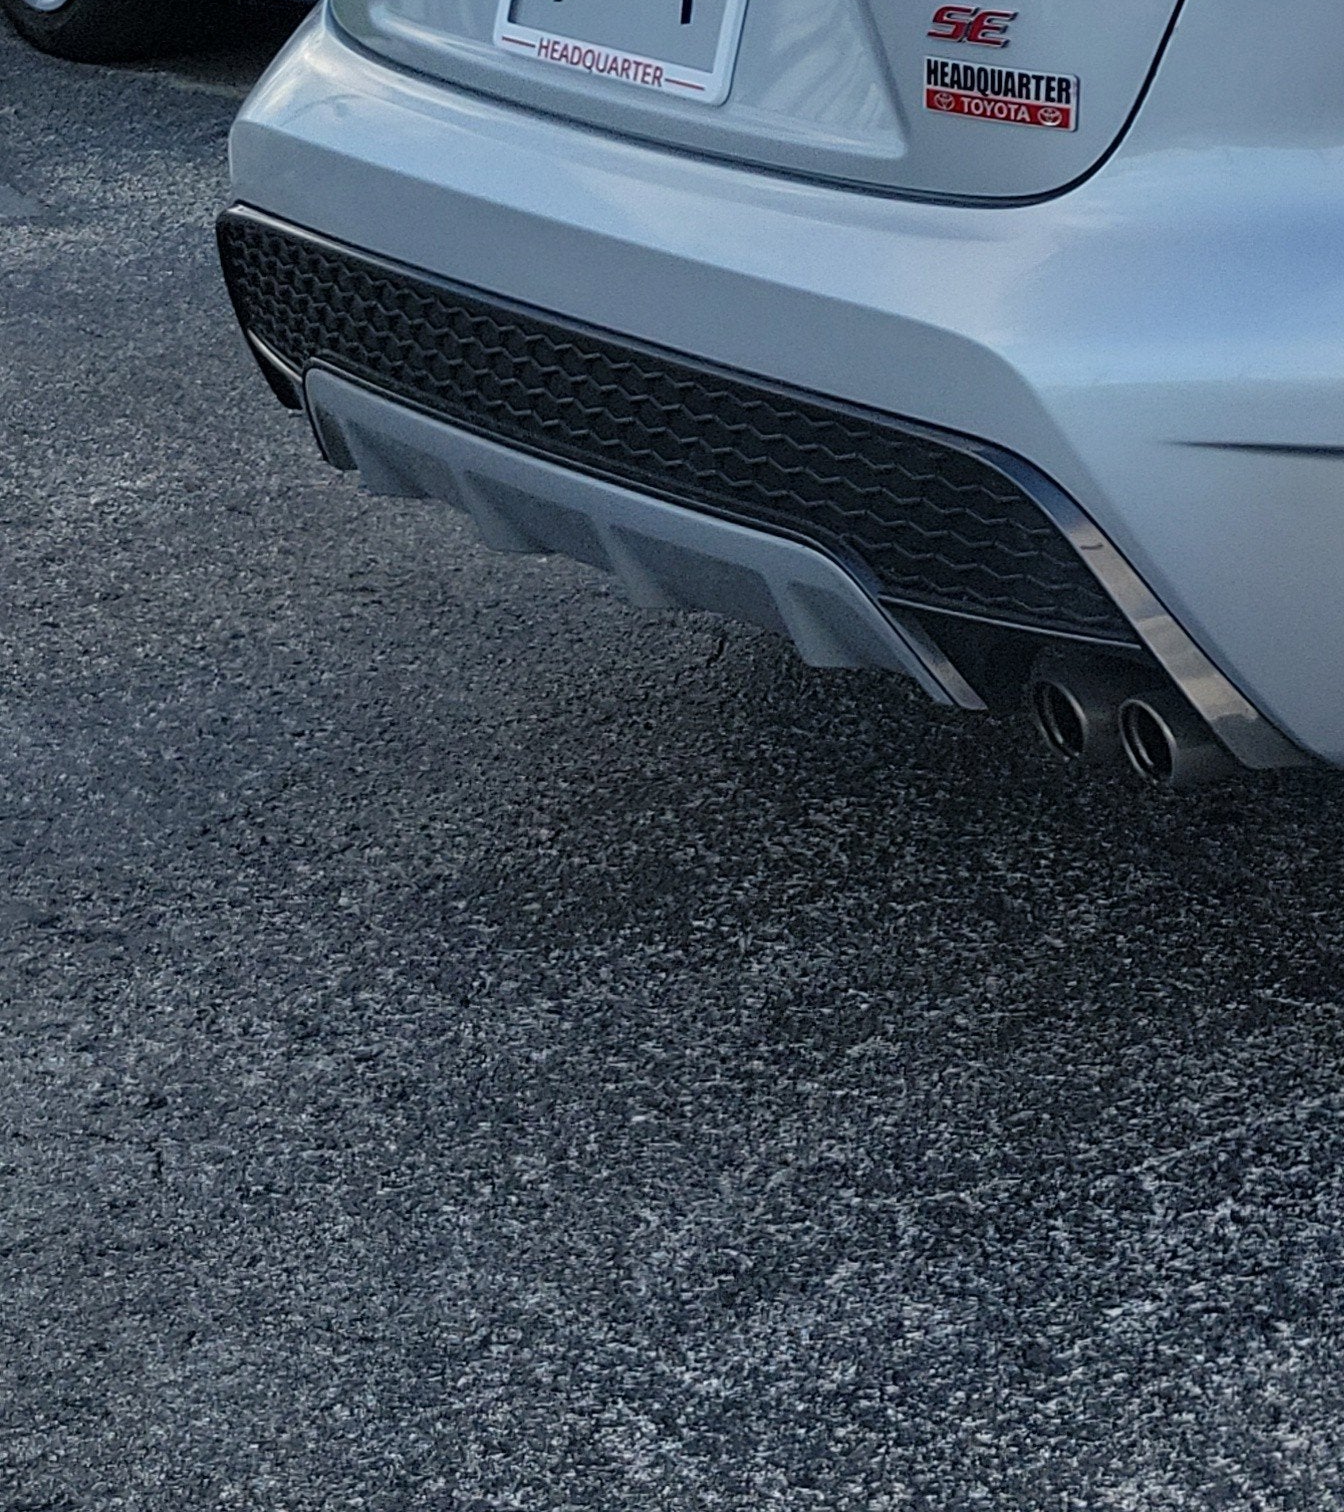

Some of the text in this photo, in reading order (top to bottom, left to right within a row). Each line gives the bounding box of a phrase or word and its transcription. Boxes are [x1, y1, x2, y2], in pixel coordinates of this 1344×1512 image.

[927, 4, 1019, 48] SE
[537, 36, 664, 88] HEADQUARTER
[926, 58, 1072, 105] HEADQUARTER
[960, 96, 1031, 123] TOYOTA
